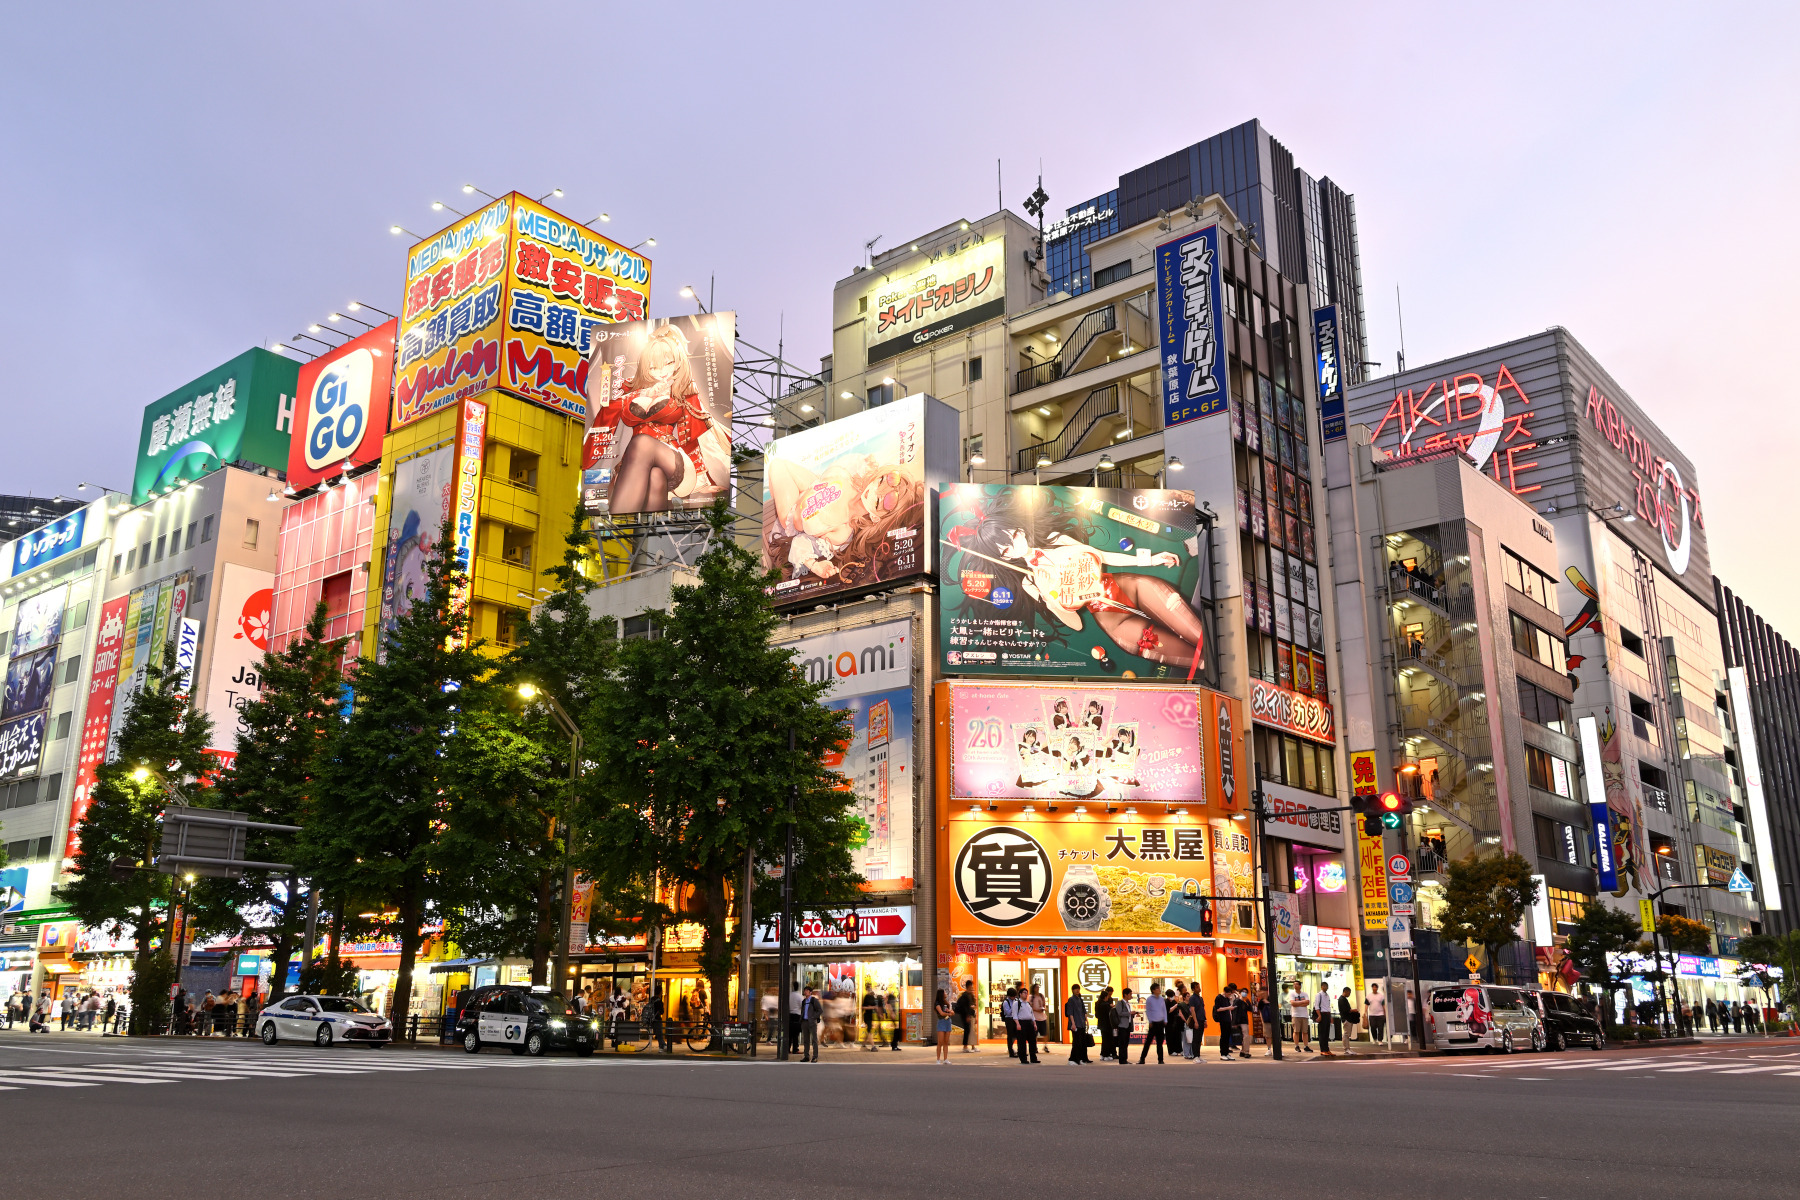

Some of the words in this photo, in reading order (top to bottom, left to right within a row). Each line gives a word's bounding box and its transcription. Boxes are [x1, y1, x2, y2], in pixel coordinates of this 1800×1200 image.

[405, 233, 505, 322] 激安販売
[515, 239, 645, 322] 激安販売
[878, 266, 993, 333] メイドカジノ
[1164, 258, 1176, 338] トレーディングカードゲーム
[400, 281, 502, 370] 高額買取
[397, 339, 499, 421] Mulan
[1166, 354, 1180, 405] 秋葉原店
[1371, 363, 1530, 443] AKIBA
[147, 378, 237, 457] 廣瀬無線
[594, 433, 613, 441] 5.20
[593, 447, 613, 455] 6.12
[907, 422, 916, 463] ライオン
[1632, 469, 1680, 550] ZONE
[894, 539, 913, 551] 5.20
[897, 553, 915, 566] 6.11
[1251, 683, 1332, 737] メイドカジノ
[1058, 849, 1100, 861] チケット
[1105, 827, 1206, 862] 大黒屋
[1394, 860, 1405, 870] 40
[964, 840, 1043, 914] 質
[1373, 855, 1386, 898] FREE
[1280, 909, 1291, 928] 22
[1081, 964, 1108, 988] 質
[505, 1025, 521, 1041] GO
